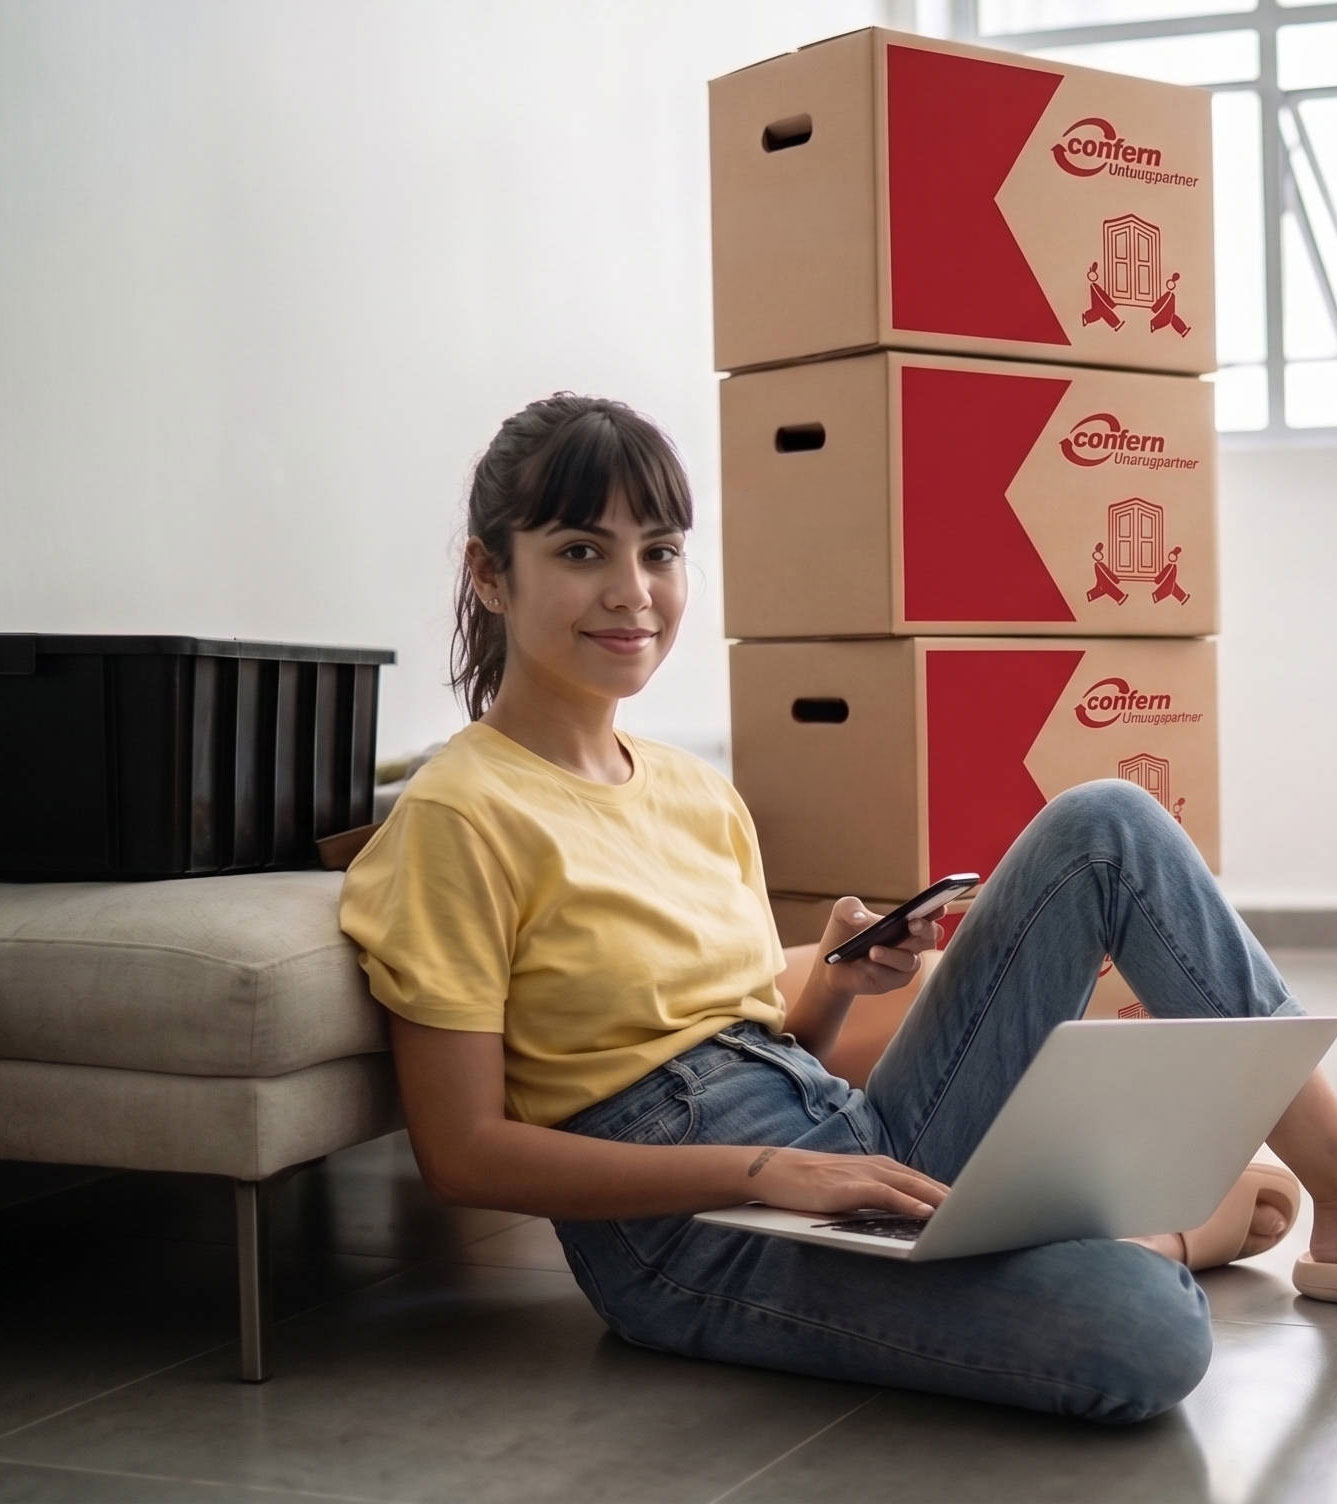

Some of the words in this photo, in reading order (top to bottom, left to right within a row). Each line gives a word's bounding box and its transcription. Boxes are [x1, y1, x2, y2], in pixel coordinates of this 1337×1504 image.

[1067, 138, 1162, 167] confern
[1073, 429, 1165, 453] confern
[1087, 690, 1171, 710] confern
